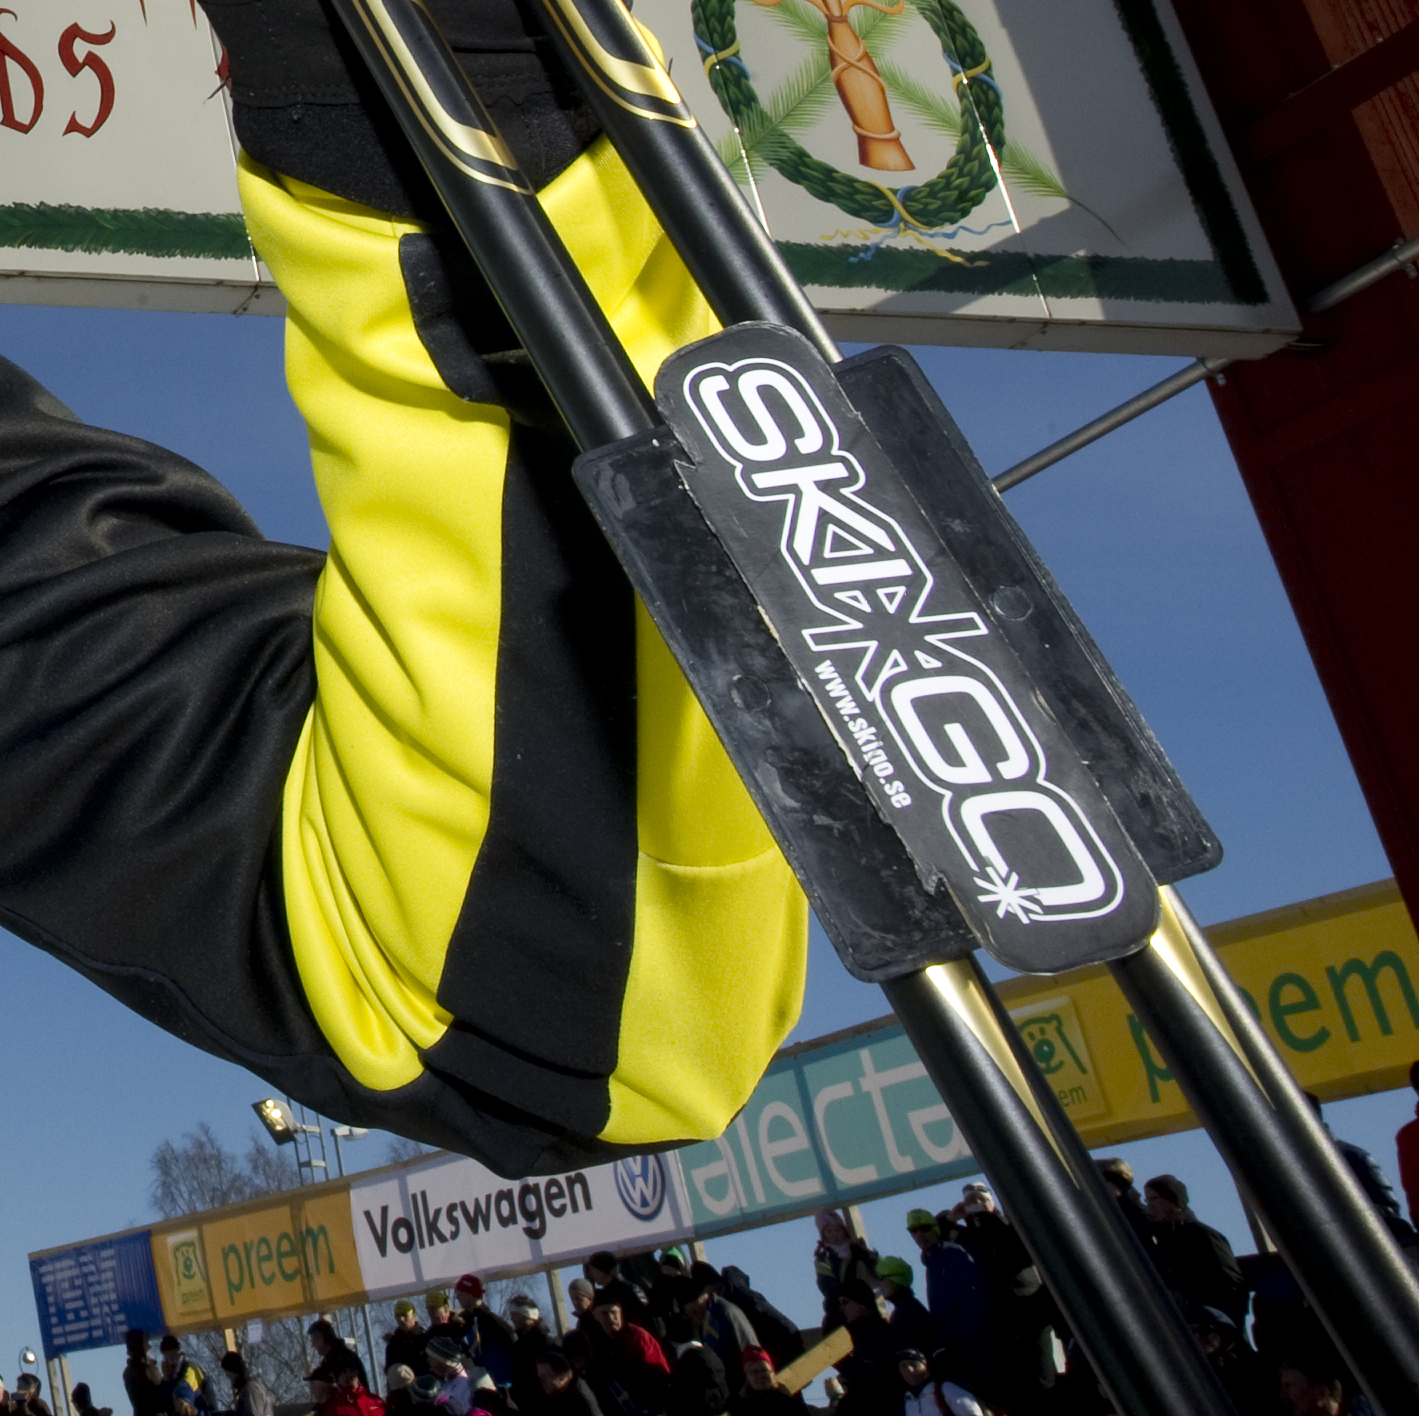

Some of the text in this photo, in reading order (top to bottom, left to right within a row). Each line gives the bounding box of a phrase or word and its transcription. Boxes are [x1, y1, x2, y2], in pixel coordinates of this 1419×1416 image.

[814, 660, 912, 810] www.skigo.se
[363, 1169, 594, 1258] Volkswagen
[220, 1222, 336, 1306] preem
